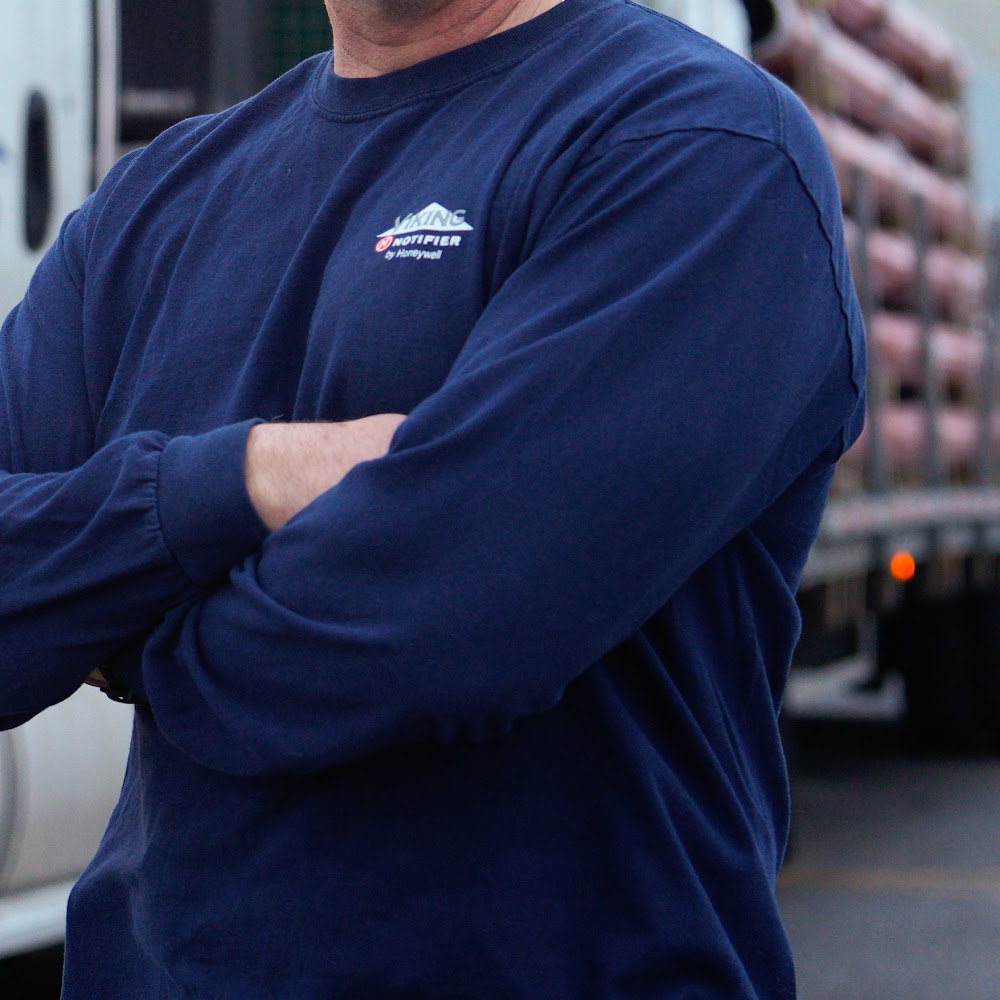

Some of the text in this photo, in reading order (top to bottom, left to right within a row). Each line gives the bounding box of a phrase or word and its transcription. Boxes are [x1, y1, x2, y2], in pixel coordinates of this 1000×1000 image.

[394, 209, 466, 232] VIKING
[392, 235, 461, 246] NOTIFIER
[385, 249, 442, 260] by Honeywell
